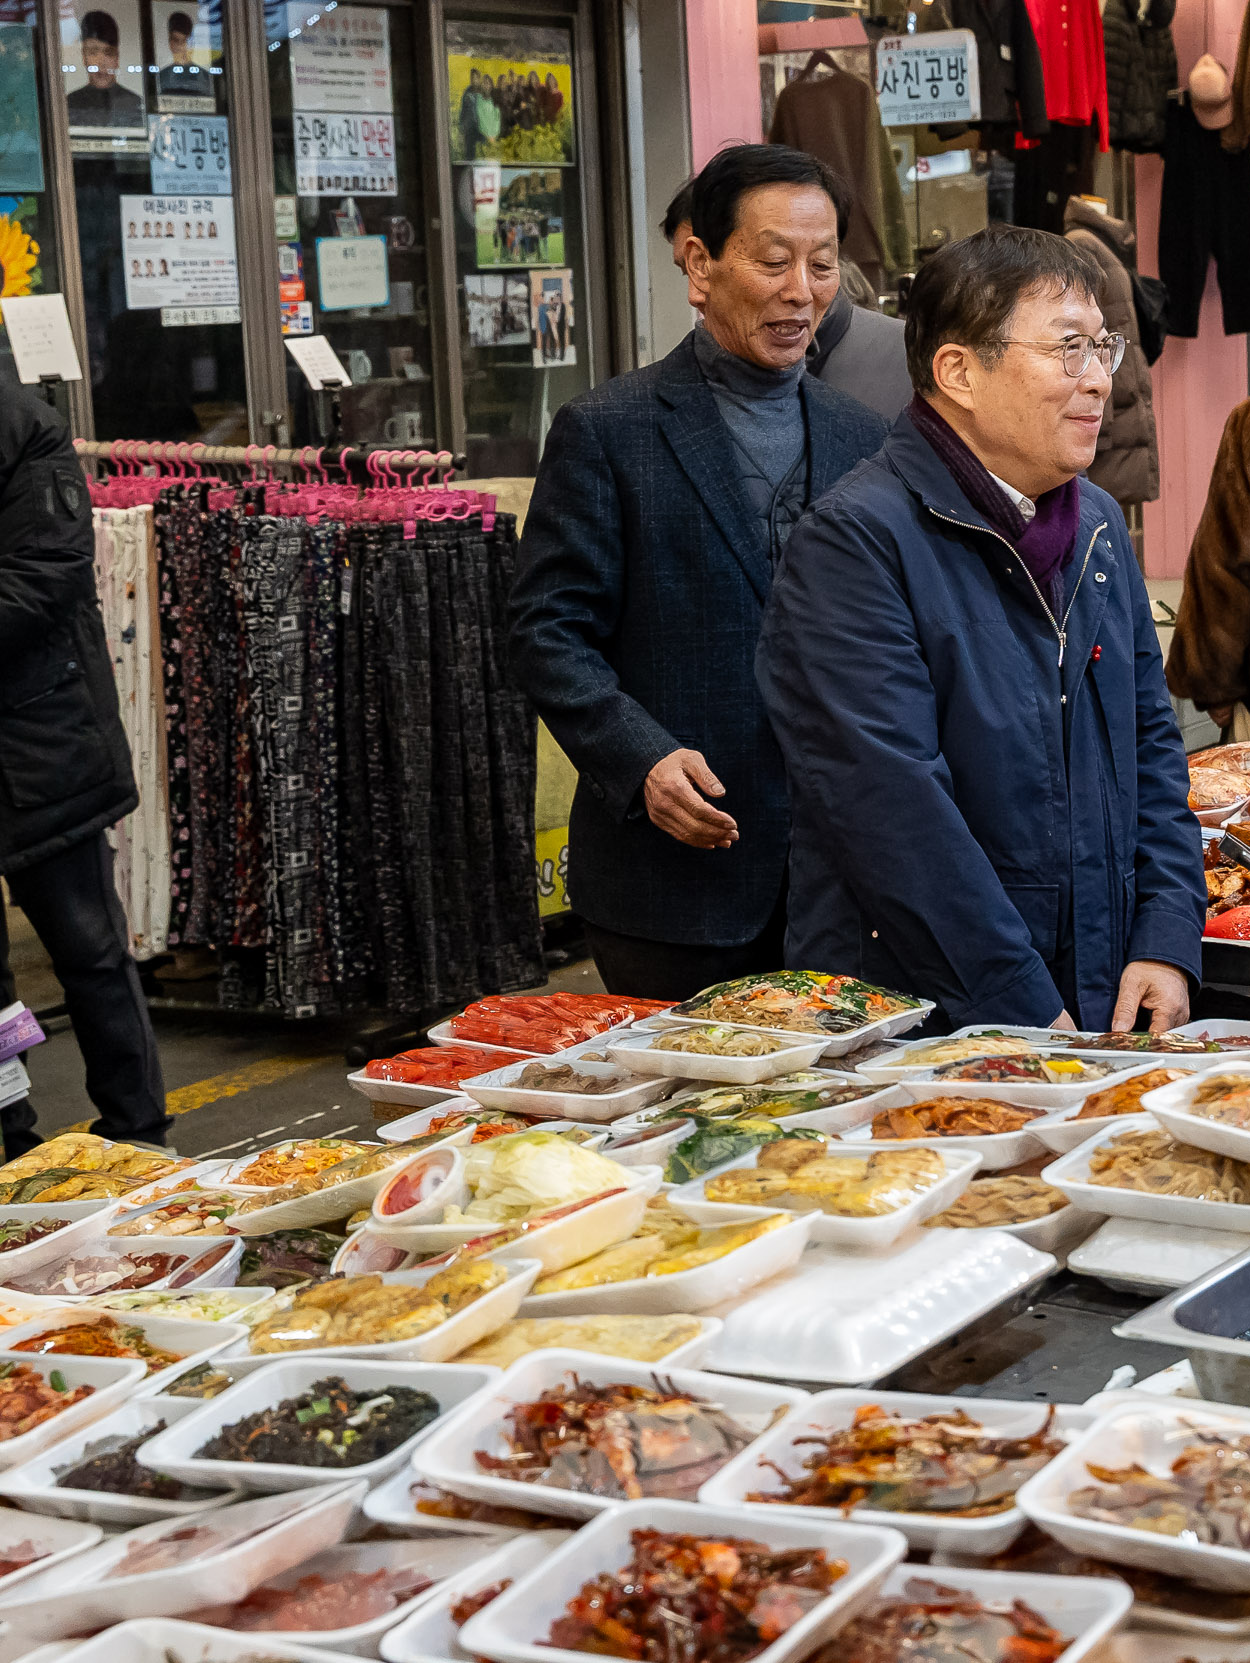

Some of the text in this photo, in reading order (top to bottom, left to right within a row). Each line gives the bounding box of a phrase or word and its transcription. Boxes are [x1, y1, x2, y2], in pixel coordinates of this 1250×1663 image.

[881, 57, 967, 99] 사진공방
[151, 127, 228, 171] 사진공방
[297, 115, 392, 157] 증명사진 만원
